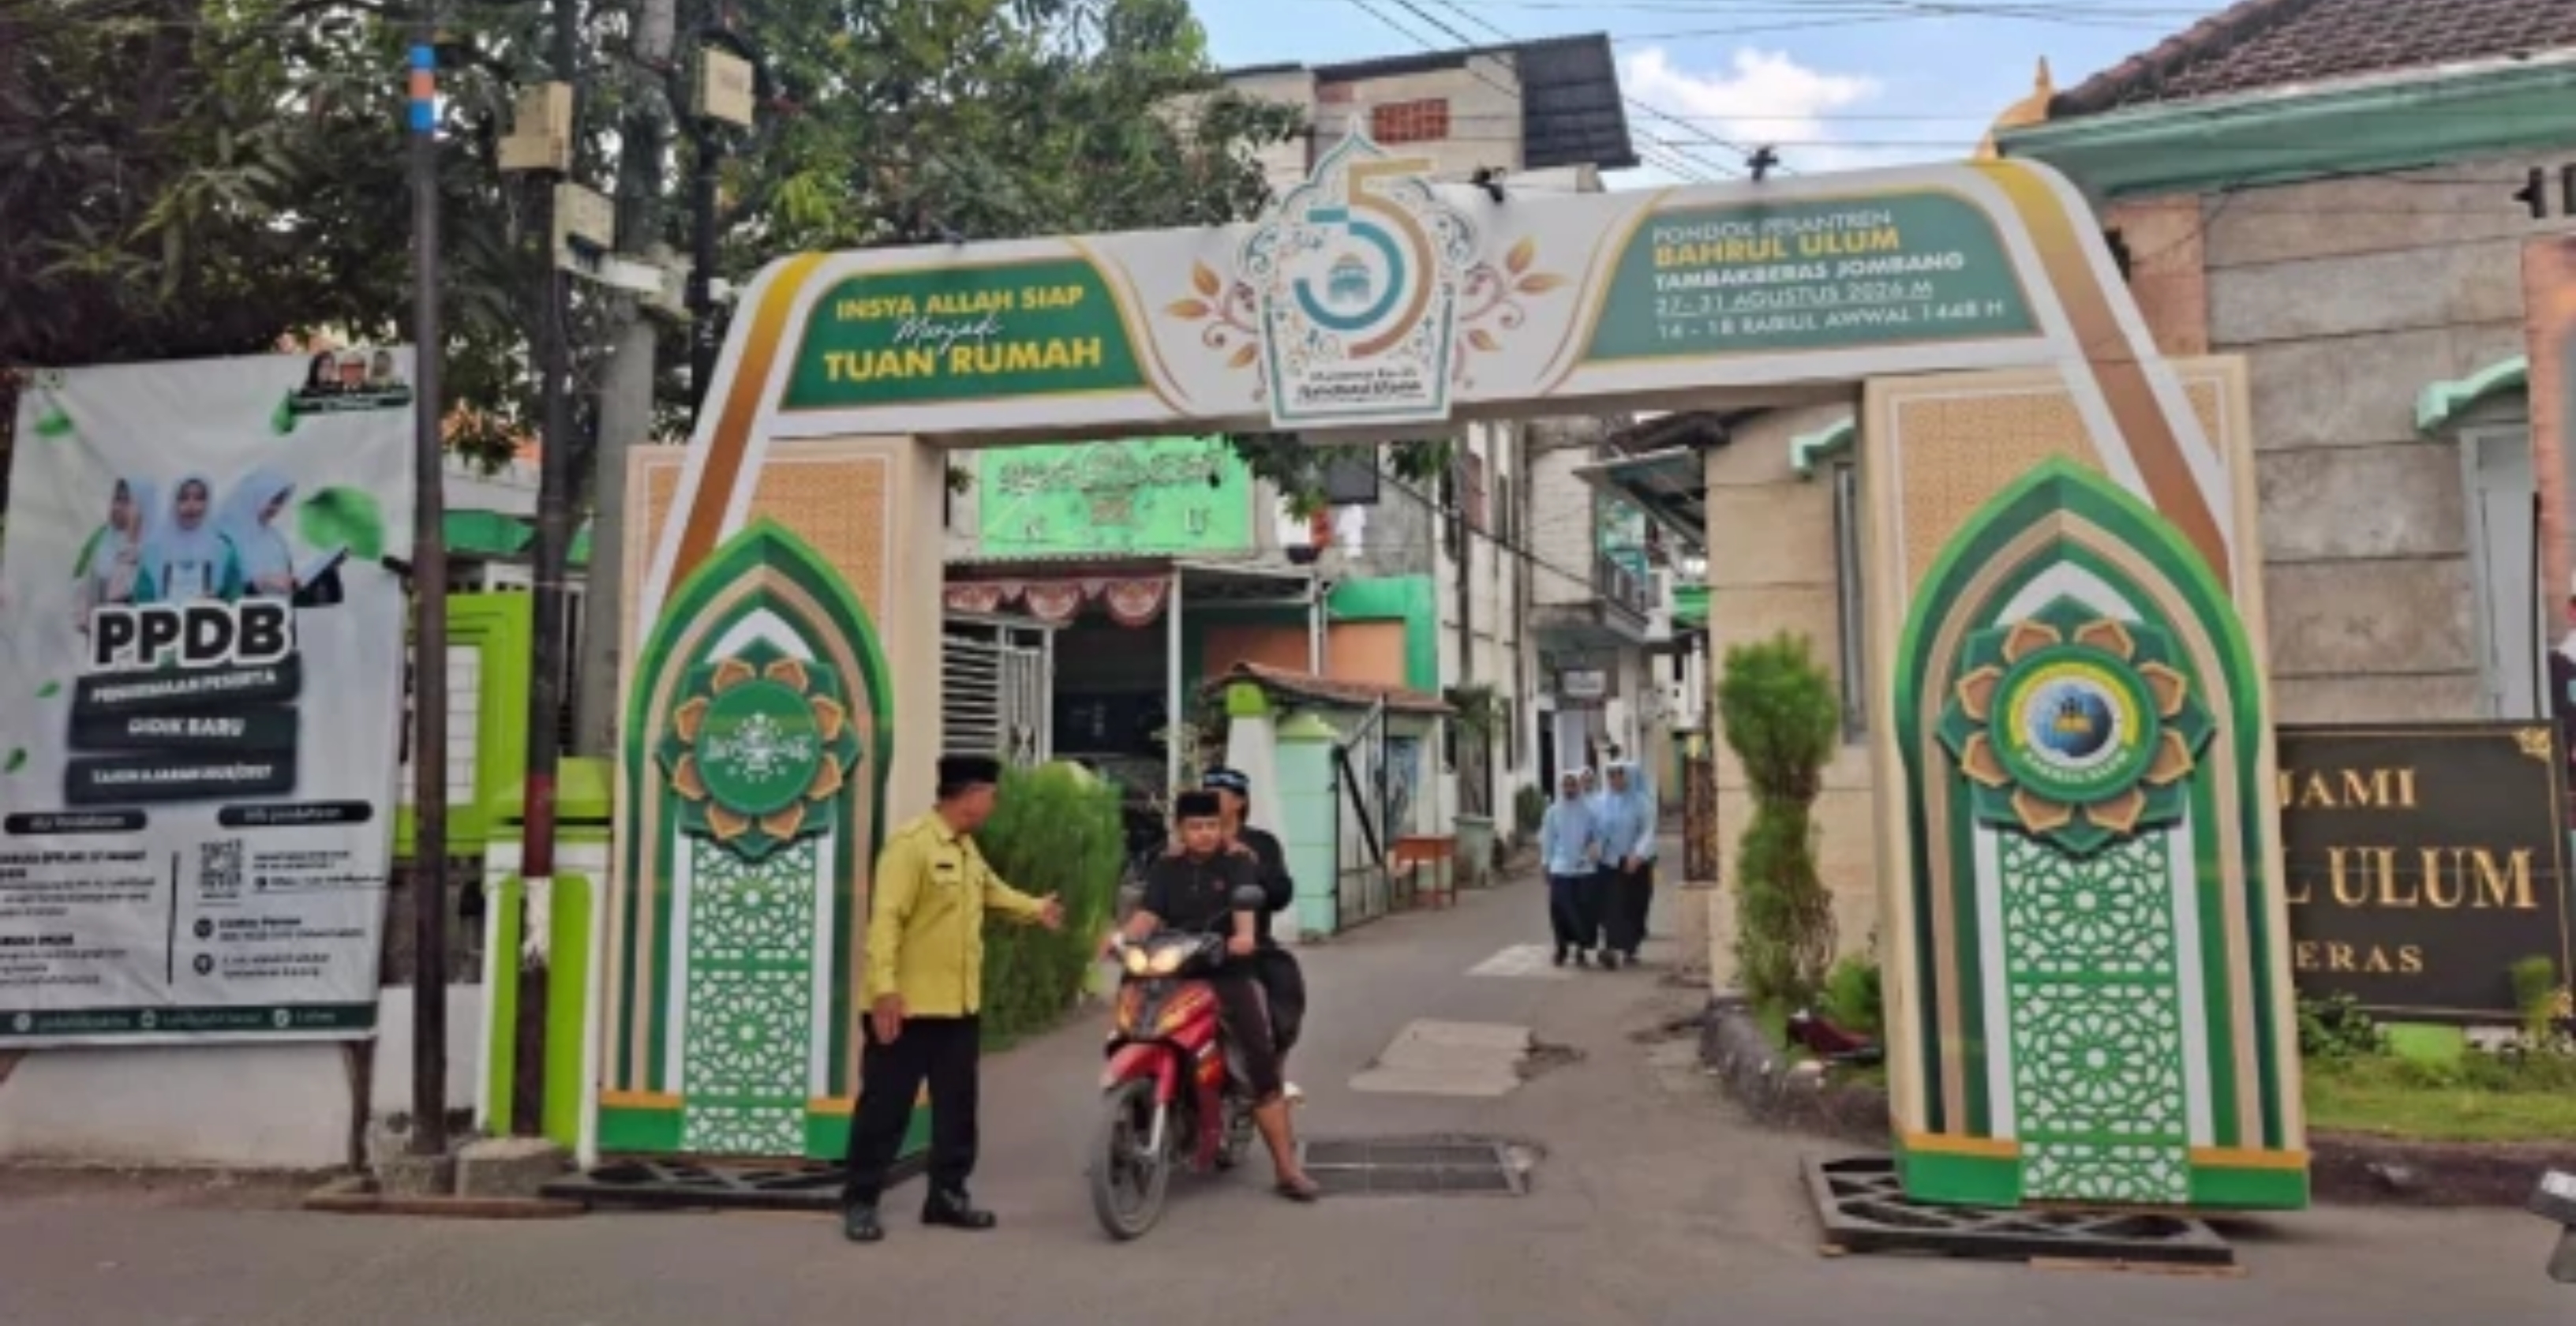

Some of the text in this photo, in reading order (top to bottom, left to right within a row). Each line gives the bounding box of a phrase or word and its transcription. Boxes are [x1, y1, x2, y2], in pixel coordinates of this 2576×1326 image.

[1653, 208, 1892, 244] PONDOK PESANTREN
[1654, 225, 1900, 268] BAHRUL ULUM
[1654, 251, 1964, 293] TAMBAKBERAS JOMBANG
[837, 284, 1084, 321] INSYA ALLAH SIAP
[1733, 283, 1840, 313] AGUSTUS
[1911, 279, 1933, 300] M
[1825, 305, 1911, 330] AWWAL
[1986, 298, 2004, 318] H
[892, 311, 1005, 356] Menjadi
[825, 337, 1102, 382] TUAN RUMAH
[93, 603, 287, 666] PPDB
[202, 669, 276, 693] PESERTA
[127, 716, 245, 736] DIDIK BARU
[2327, 846, 2539, 909] ULUM
